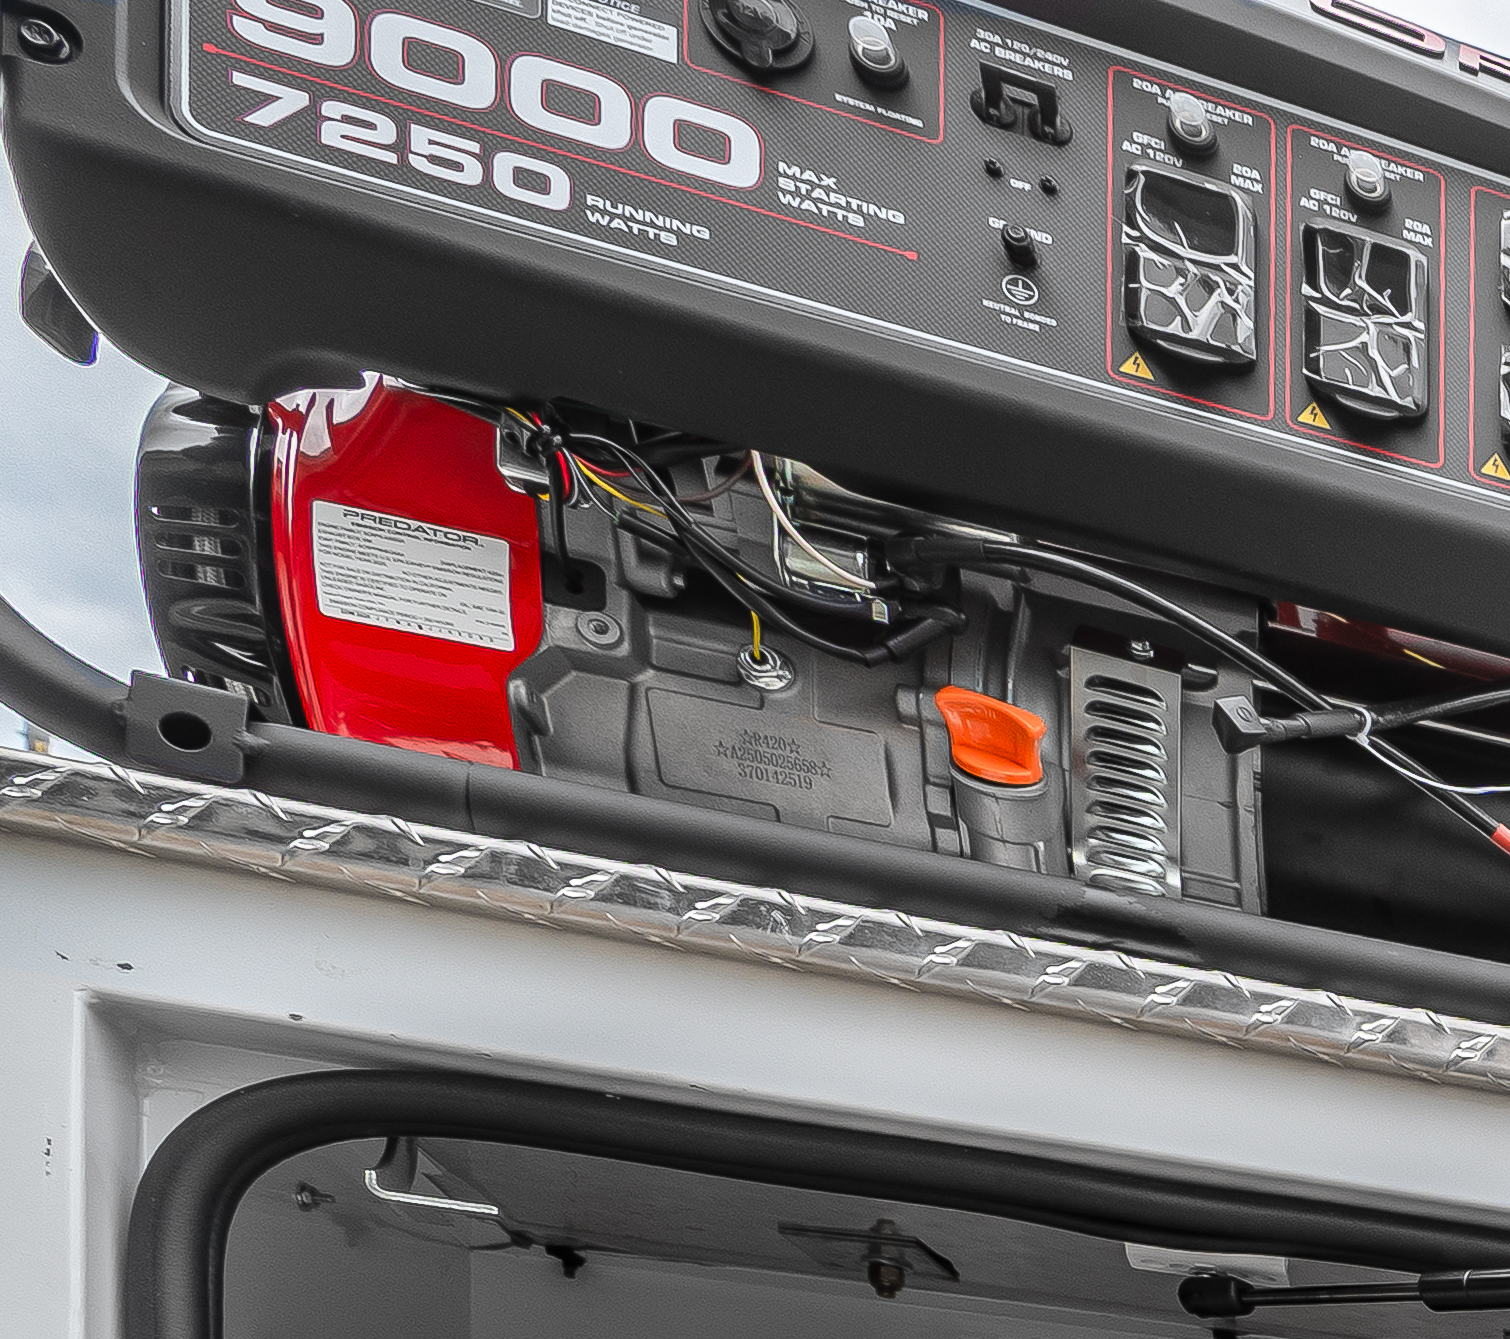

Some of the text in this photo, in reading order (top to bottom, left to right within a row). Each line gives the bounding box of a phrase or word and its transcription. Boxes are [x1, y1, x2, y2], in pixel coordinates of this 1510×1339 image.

[970, 38, 1074, 81] AC BREAKERS
[226, 0, 764, 190] 9000
[1199, 99, 1254, 126] REAKER
[228, 68, 573, 211] 7250
[1132, 131, 1165, 150] GFCI
[777, 160, 838, 190] MAX
[1009, 178, 1032, 192] OFF
[1230, 174, 1264, 194] MAX
[777, 176, 906, 225] STARTING
[777, 191, 866, 228] WATTS
[1309, 188, 1341, 206] GFCI
[585, 209, 679, 246] WATTS
[586, 193, 712, 240] RUNNING
[1402, 229, 1434, 248] MAX
[342, 508, 480, 547] PREDATOR
[752, 732, 787, 752] R420
